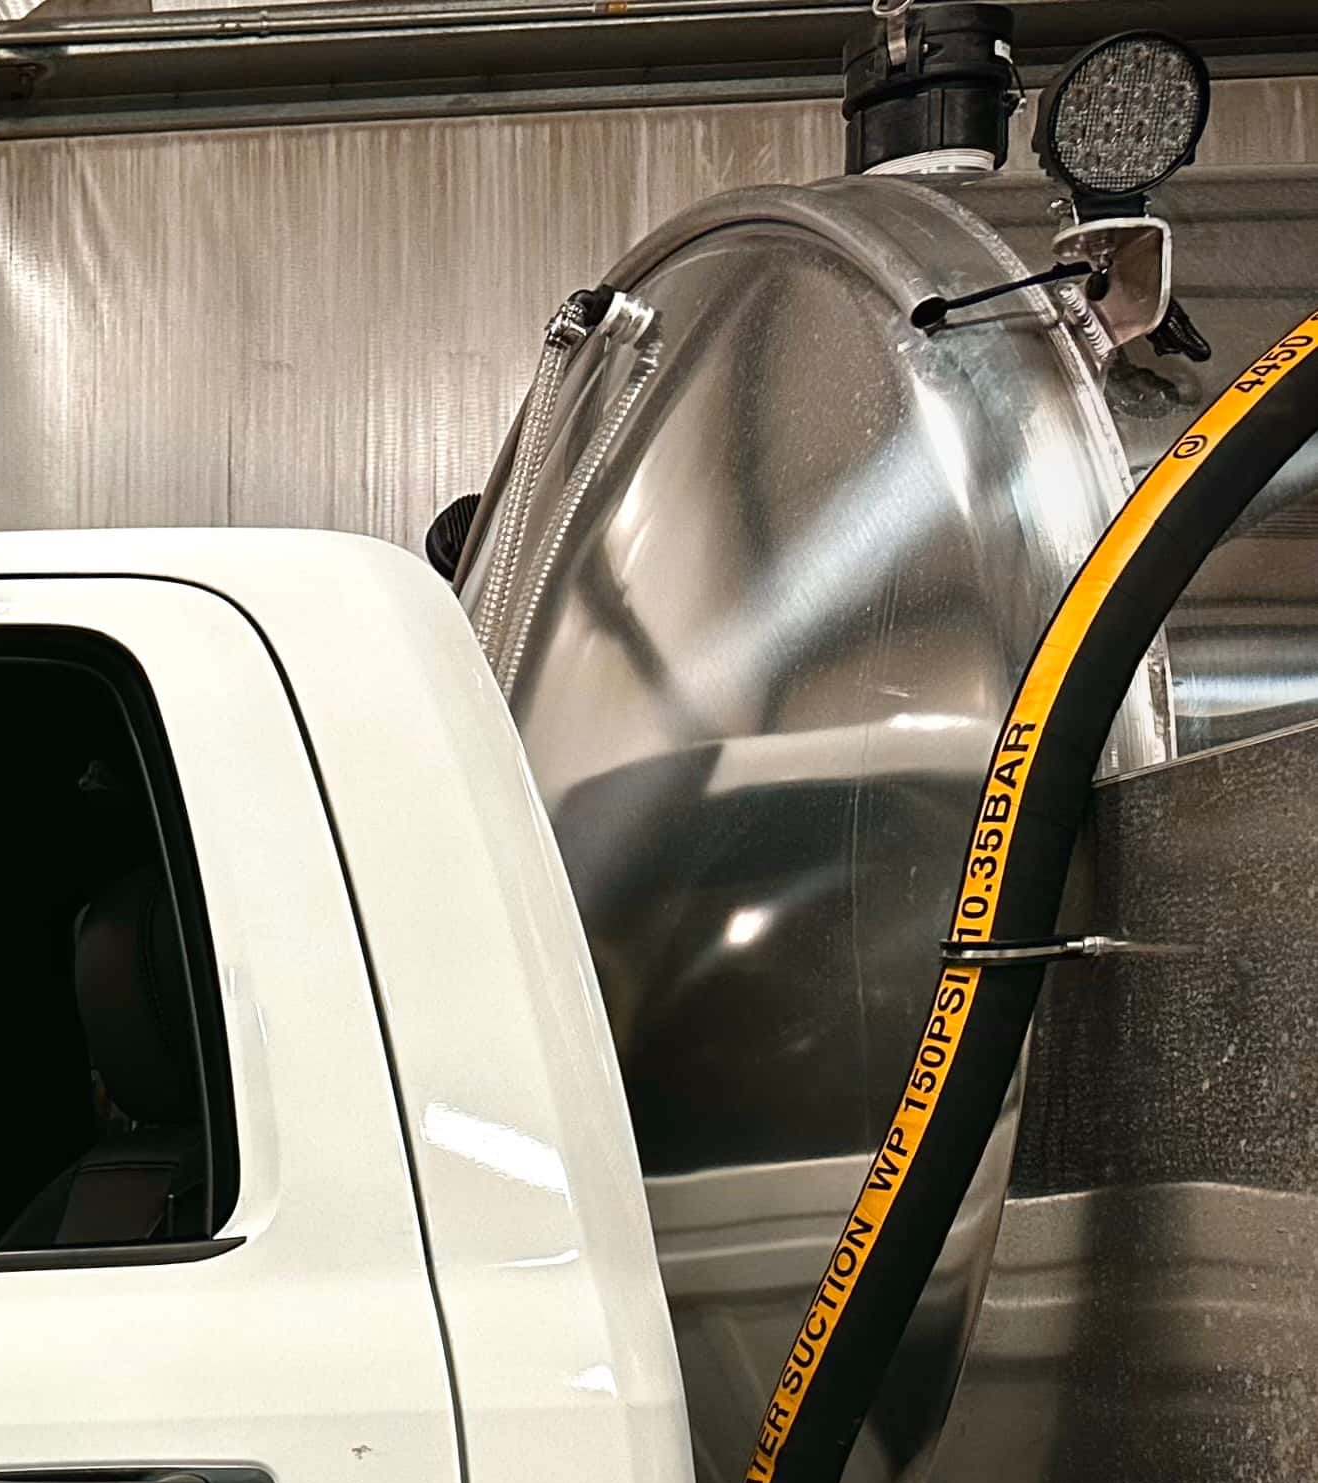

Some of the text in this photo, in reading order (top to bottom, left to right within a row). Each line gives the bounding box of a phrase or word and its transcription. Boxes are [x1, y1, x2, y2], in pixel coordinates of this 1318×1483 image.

[1235, 335, 1313, 393] 4450
[782, 1215, 874, 1395] SUCTION
[867, 1127, 908, 1191] WP
[904, 972, 971, 1112] 150PSI
[956, 721, 1036, 944] 10.35BAR
